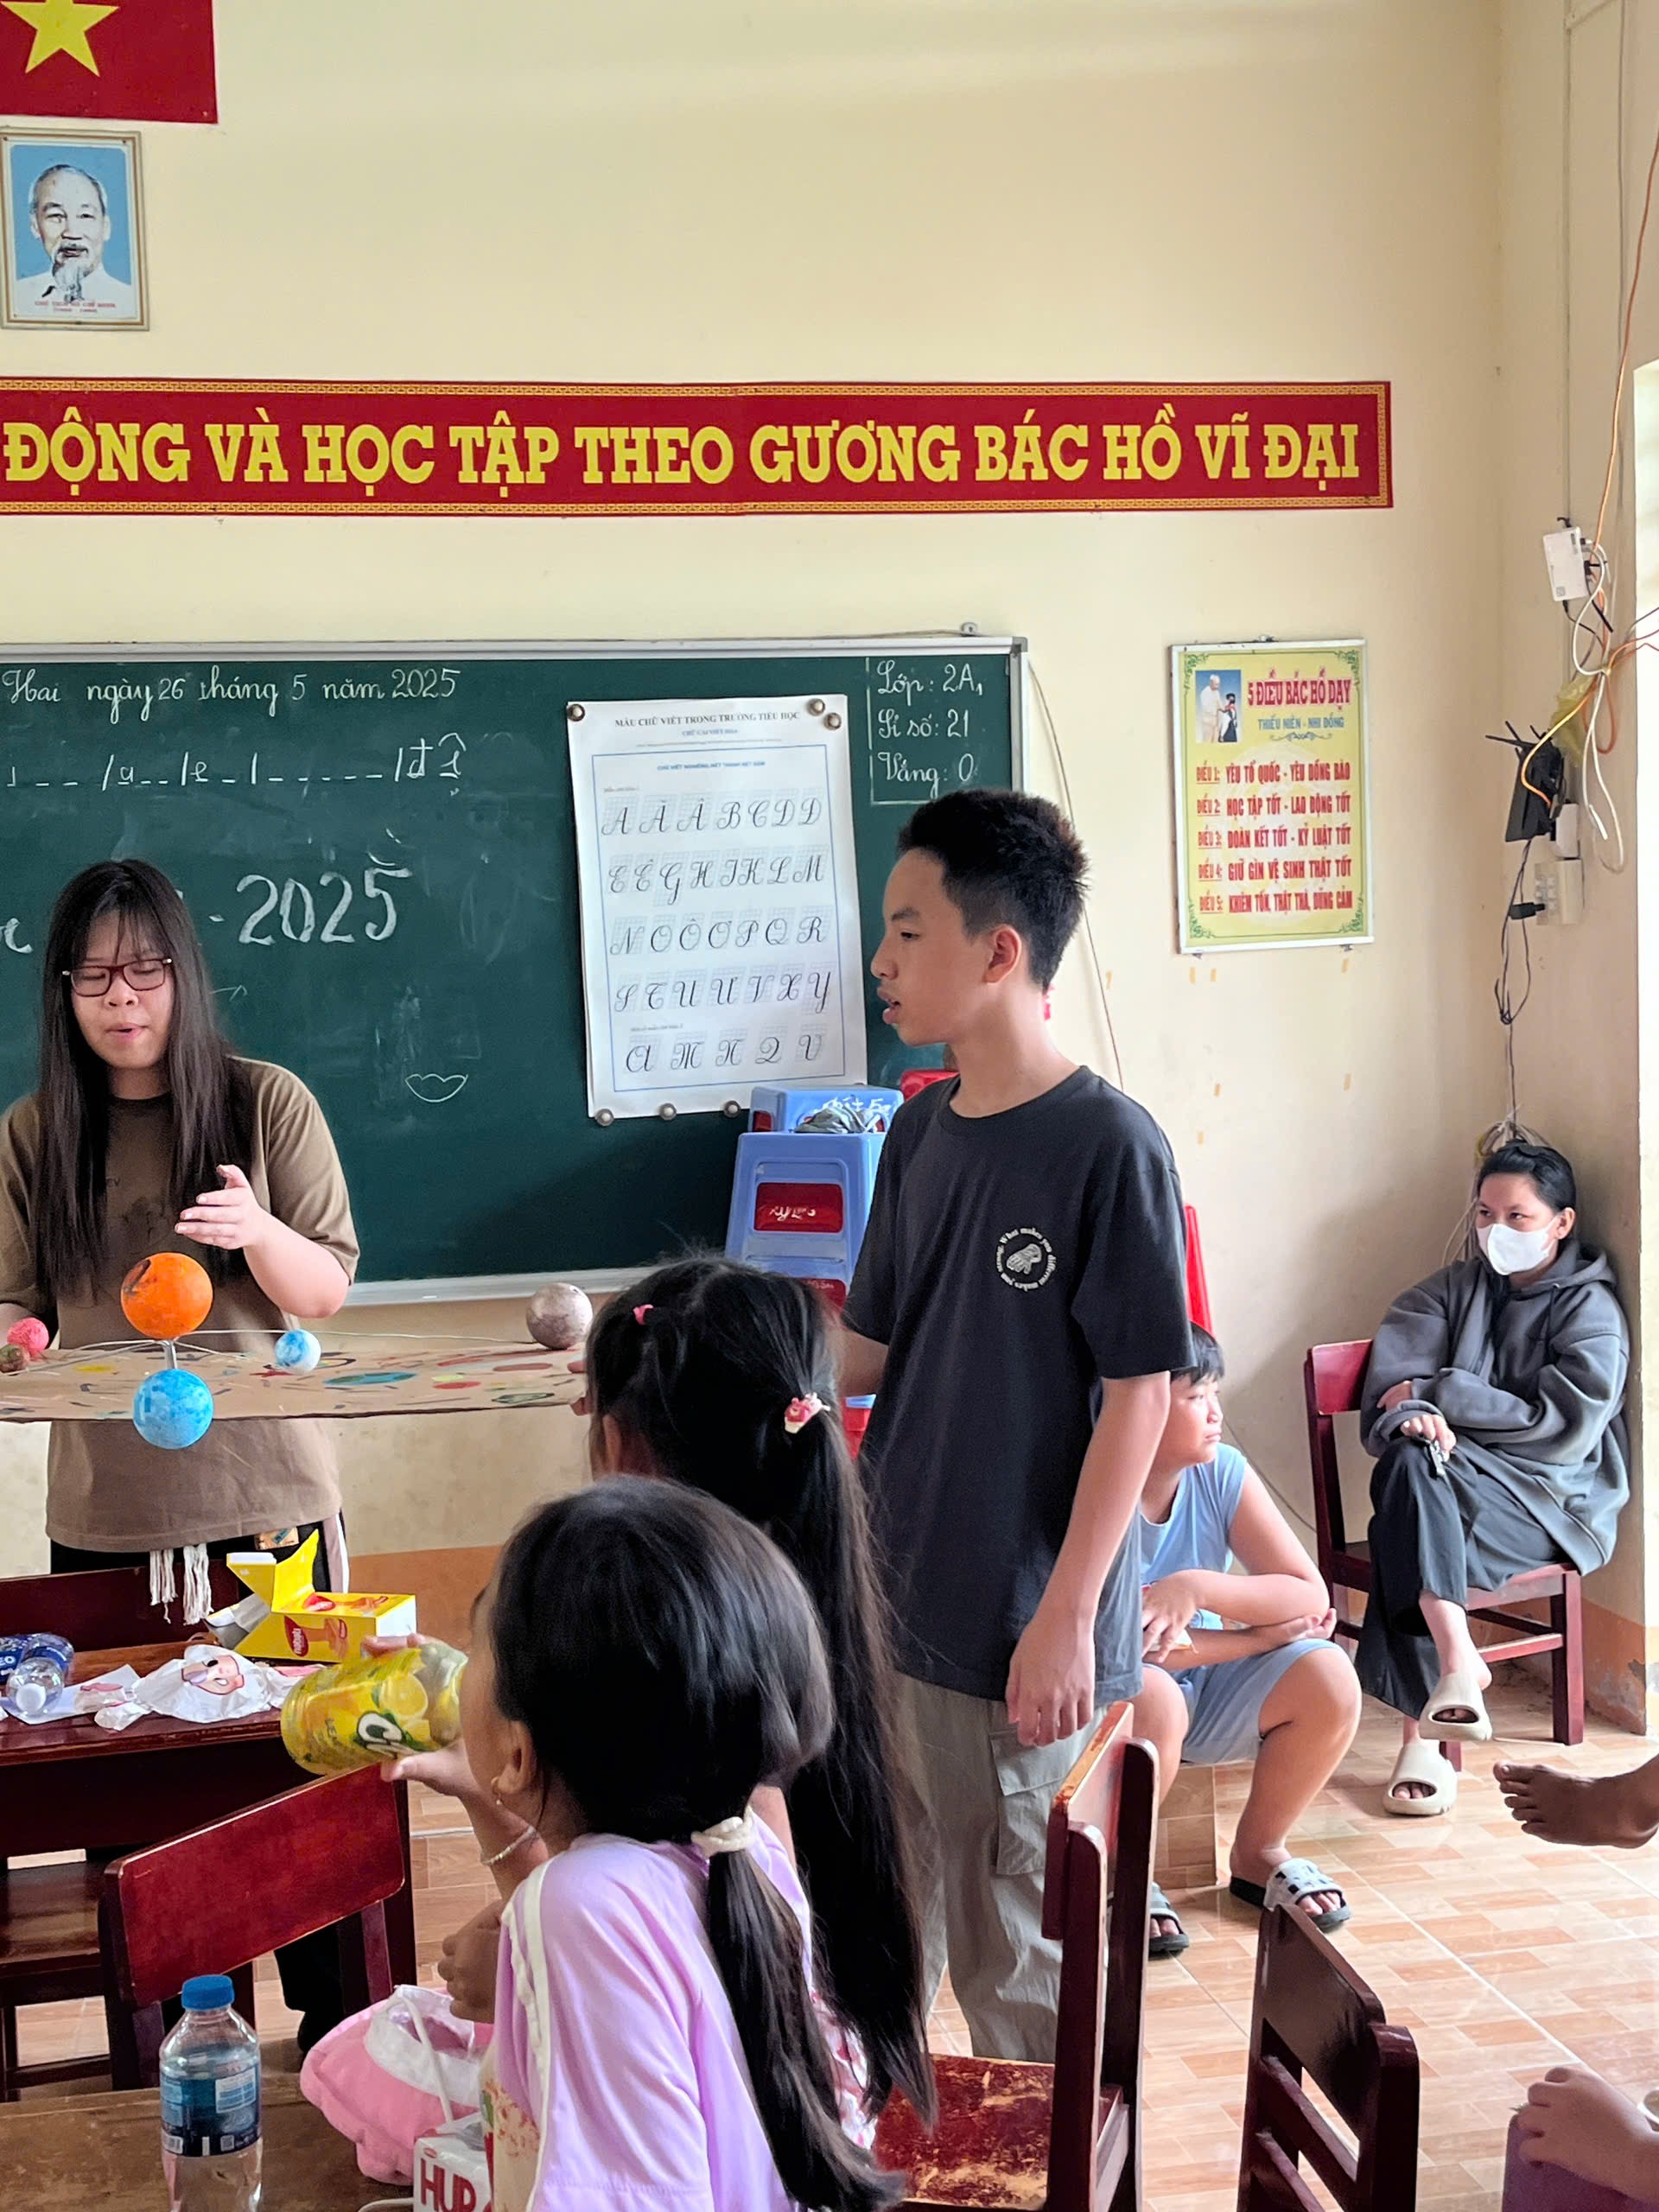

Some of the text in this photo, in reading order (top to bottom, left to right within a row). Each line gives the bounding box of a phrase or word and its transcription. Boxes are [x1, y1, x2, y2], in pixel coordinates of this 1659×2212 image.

[3, 403, 1359, 497] ĐỘNG VÀ HỌC TẬP THEO GƯƠNG BÁC HỒ VĨ ĐẠI
[2, 664, 461, 724] Hai ngày 26 tháng 5 năm 2025
[1248, 668, 1351, 710] 5 ĐIỀU BÁC HỒ DẠY
[907, 714, 938, 737] số:
[947, 709, 969, 737] 21
[959, 753, 974, 781] 0
[601, 807, 631, 836] A
[677, 798, 706, 831] Â
[717, 802, 741, 830] B
[748, 800, 770, 828] C
[771, 799, 795, 827] D
[609, 865, 626, 893] E
[634, 859, 653, 891] Ê
[659, 863, 680, 906] G
[691, 861, 714, 888] H
[738, 858, 764, 885] K
[767, 857, 791, 884] L
[792, 855, 823, 882] M
[236, 868, 412, 945] 2025
[610, 917, 824, 956] N O Ô Ơ P Q R
[614, 971, 831, 1014] S T U Ư V X Y
